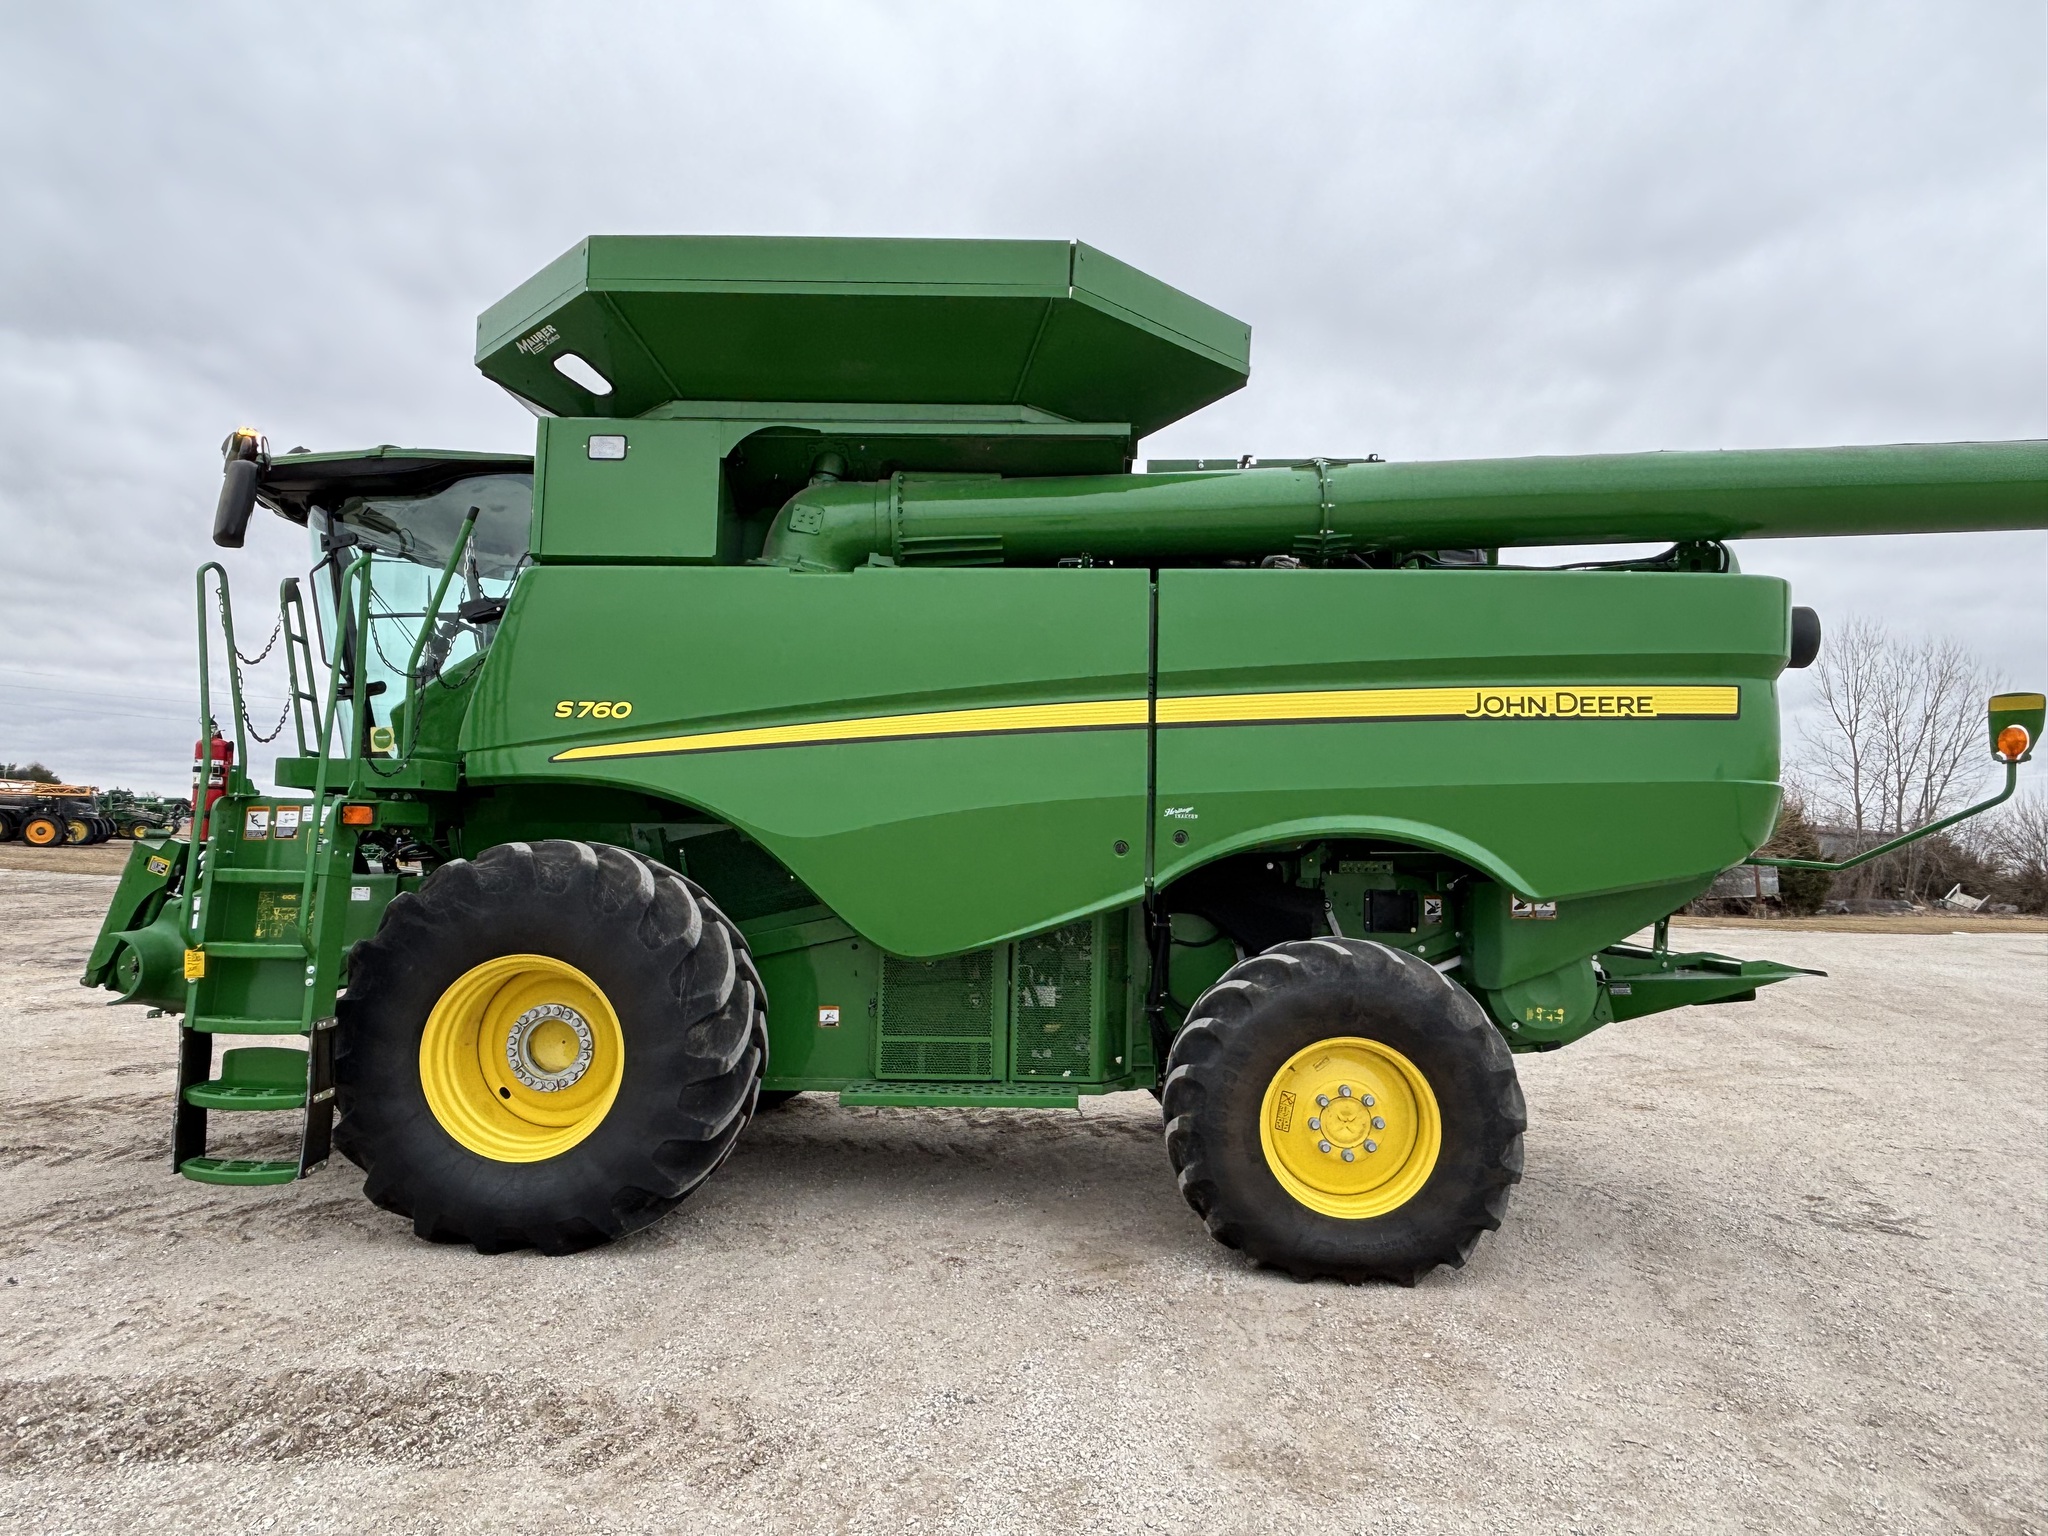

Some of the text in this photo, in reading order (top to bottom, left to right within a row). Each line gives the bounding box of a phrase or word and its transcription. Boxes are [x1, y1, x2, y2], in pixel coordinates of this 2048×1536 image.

[515, 324, 557, 355] MAURER
[554, 700, 633, 719] S760
[1465, 692, 1654, 714] JOHN DEERE
